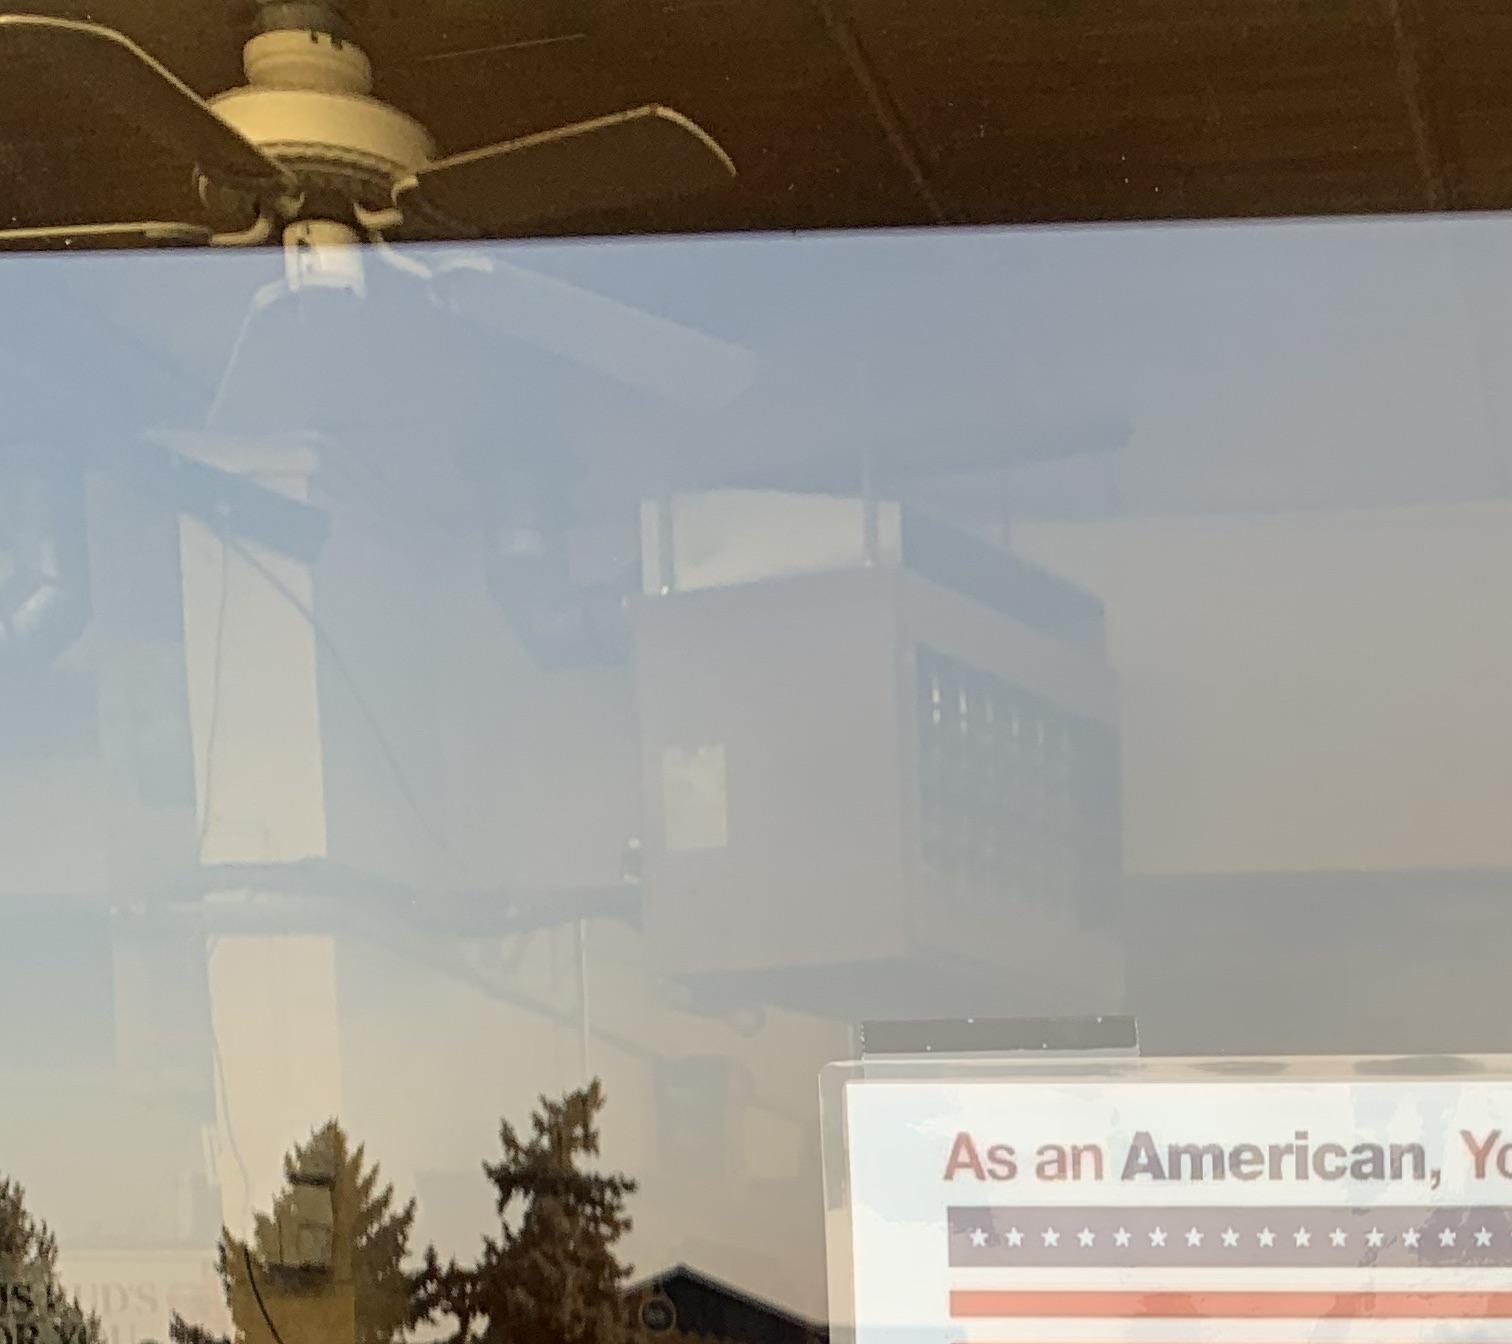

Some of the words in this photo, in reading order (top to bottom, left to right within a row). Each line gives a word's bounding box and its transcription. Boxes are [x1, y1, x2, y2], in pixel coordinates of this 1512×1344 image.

[942, 1133, 1017, 1184] As
[1034, 1143, 1104, 1184] an
[1122, 1130, 1441, 1190] American,
